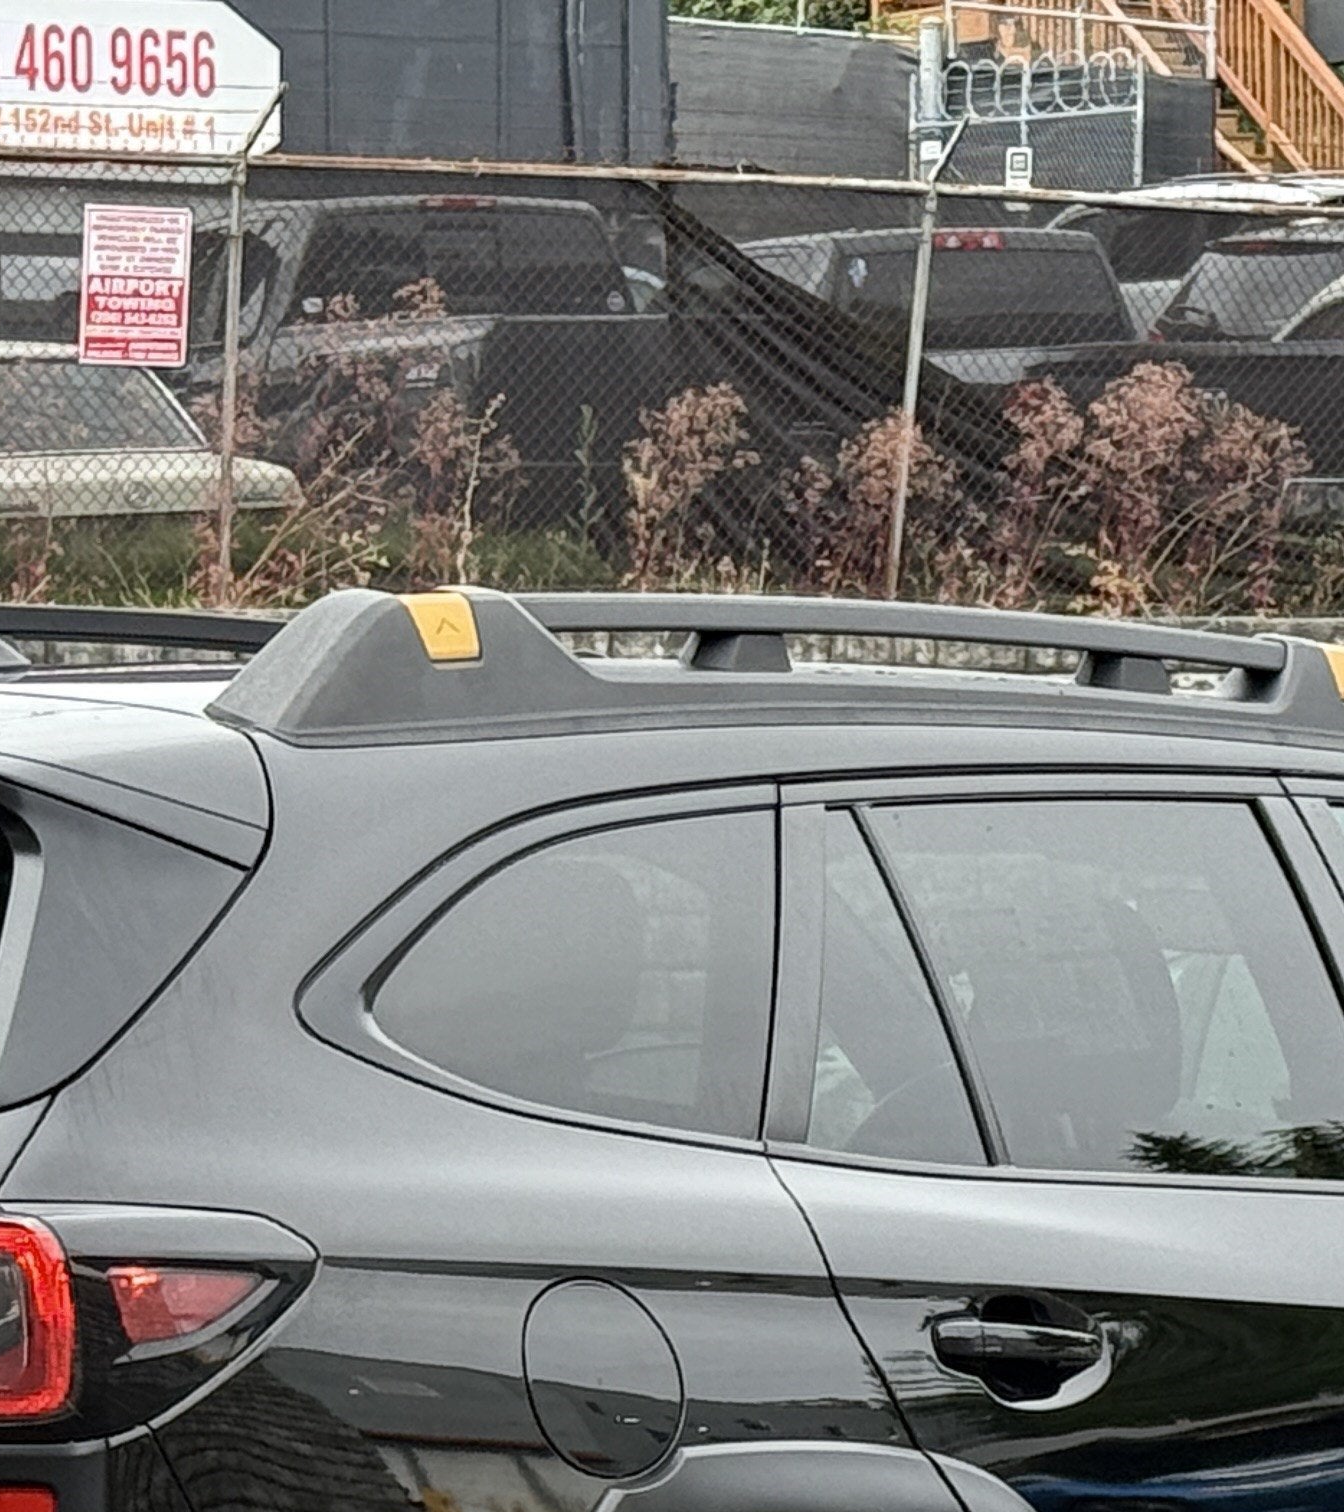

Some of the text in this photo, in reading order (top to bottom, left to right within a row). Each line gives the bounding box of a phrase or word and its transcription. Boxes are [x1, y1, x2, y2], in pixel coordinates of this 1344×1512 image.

[15, 23, 93, 93] 460
[110, 27, 216, 98] 9656
[10, 107, 80, 135] 152nd
[128, 112, 176, 140] Unit
[205, 116, 216, 139] 1
[88, 277, 184, 298] AIRPORT
[94, 296, 176, 311] TOWING
